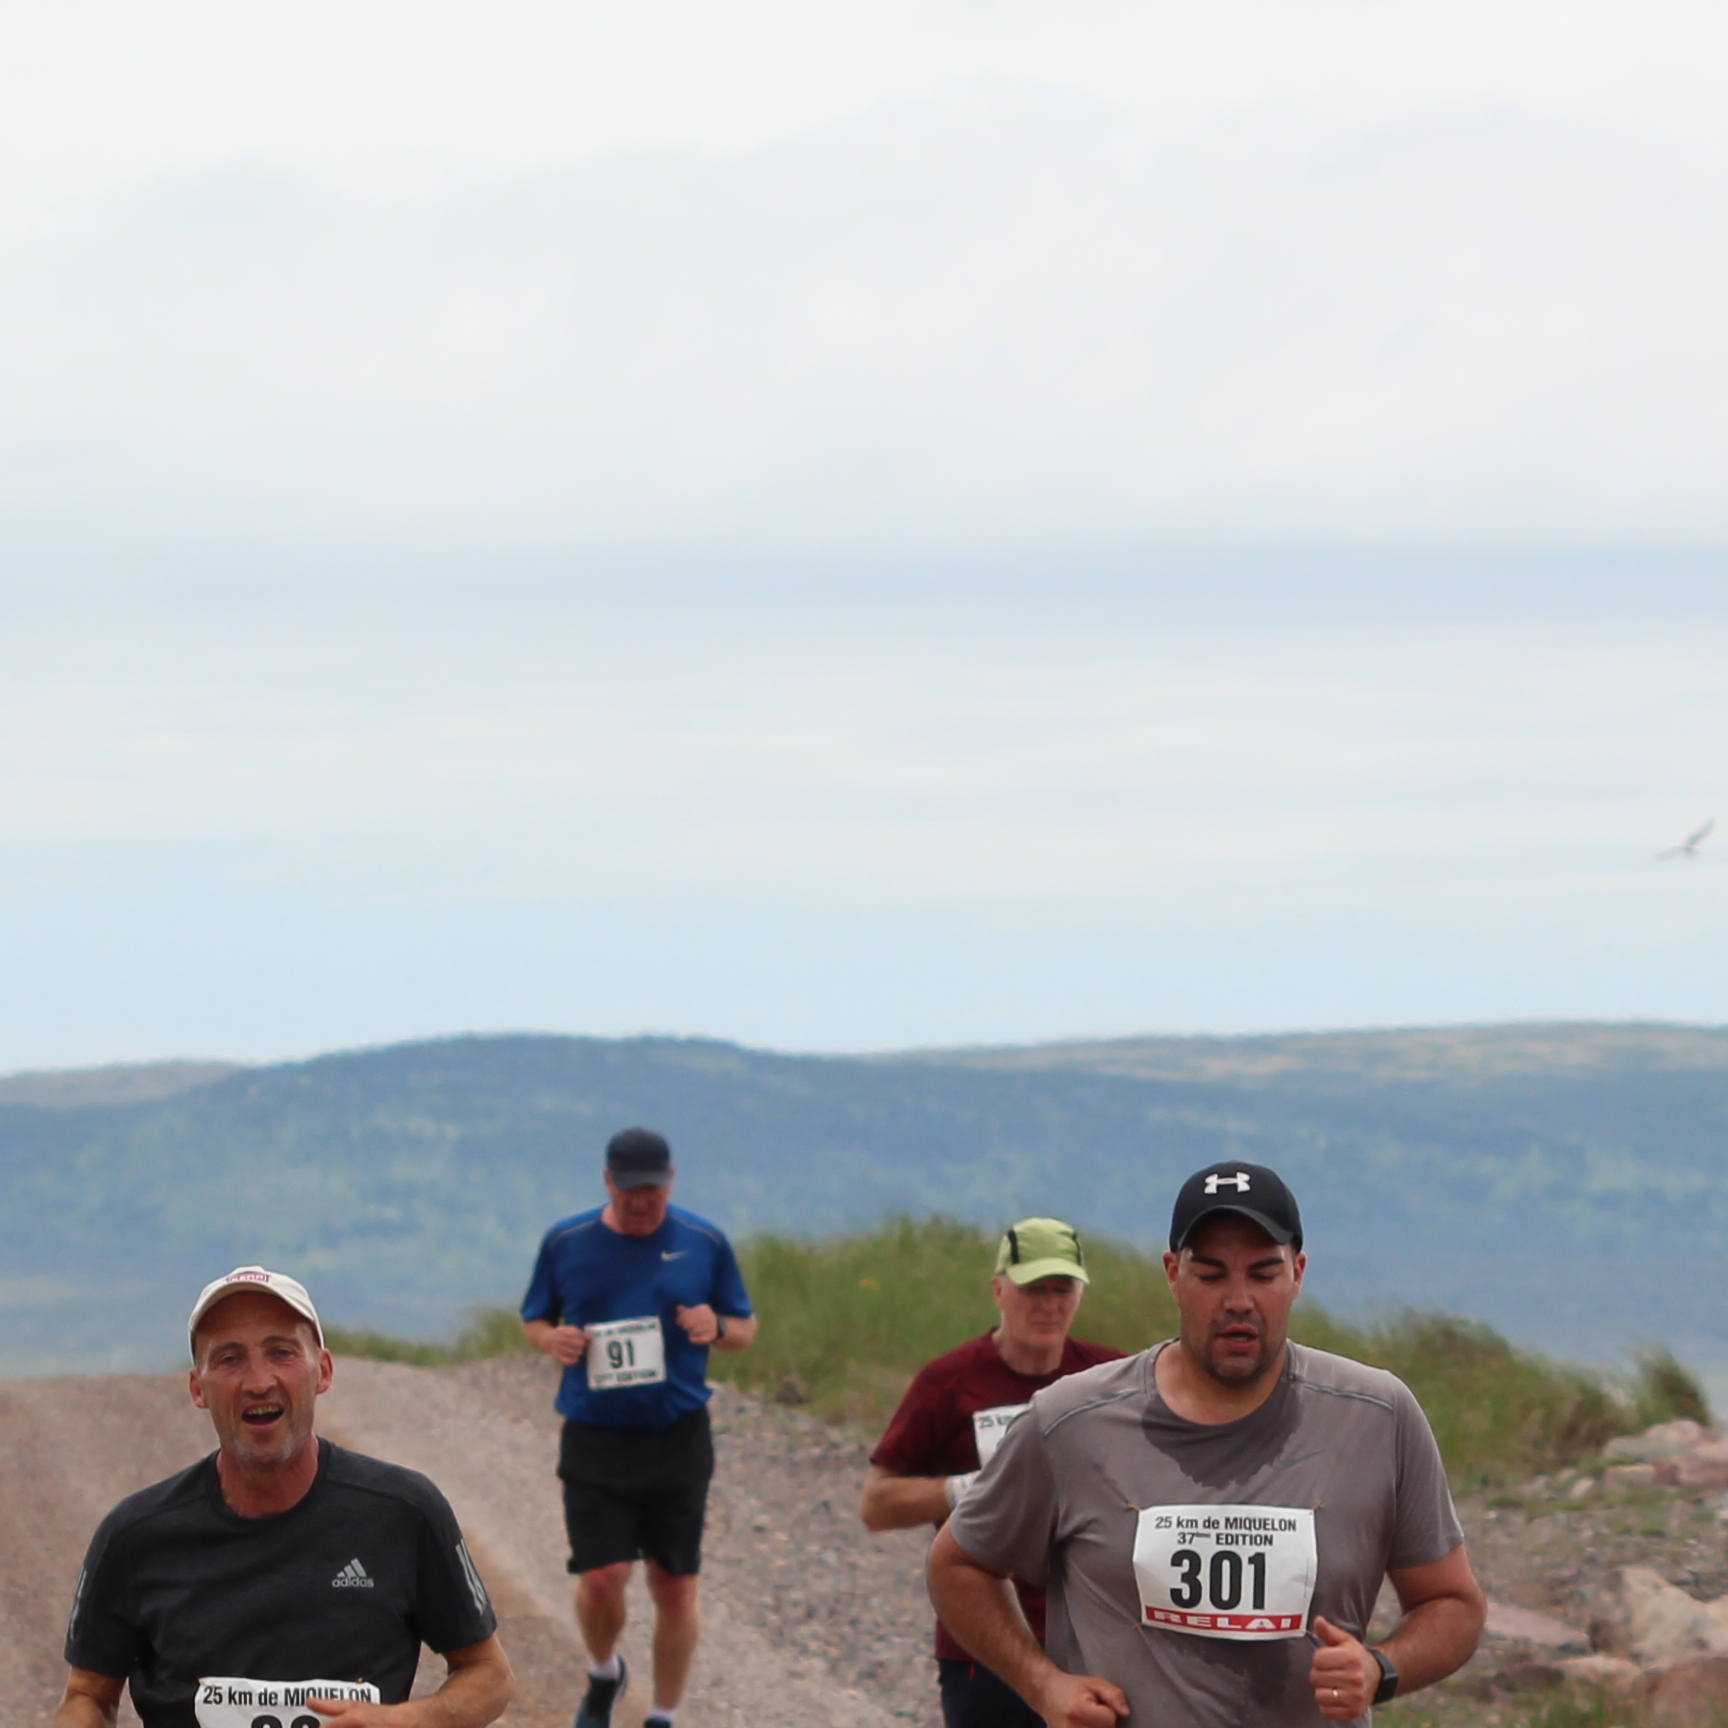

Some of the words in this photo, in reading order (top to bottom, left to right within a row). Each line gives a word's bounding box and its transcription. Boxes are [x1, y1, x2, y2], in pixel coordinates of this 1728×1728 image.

[607, 1338, 635, 1369] 91
[1154, 1516, 1172, 1529] 25
[1176, 1516, 1198, 1529] km
[1203, 1516, 1220, 1530] de
[1224, 1516, 1297, 1532] MIQUELON
[1215, 1533, 1273, 1546] EDITION
[331, 1576, 375, 1588] adidas
[1169, 1549, 1266, 1610] 301
[1153, 1610, 1292, 1630] RELAI
[202, 1687, 223, 1705] 25
[228, 1687, 253, 1706] km
[258, 1689, 278, 1707] de
